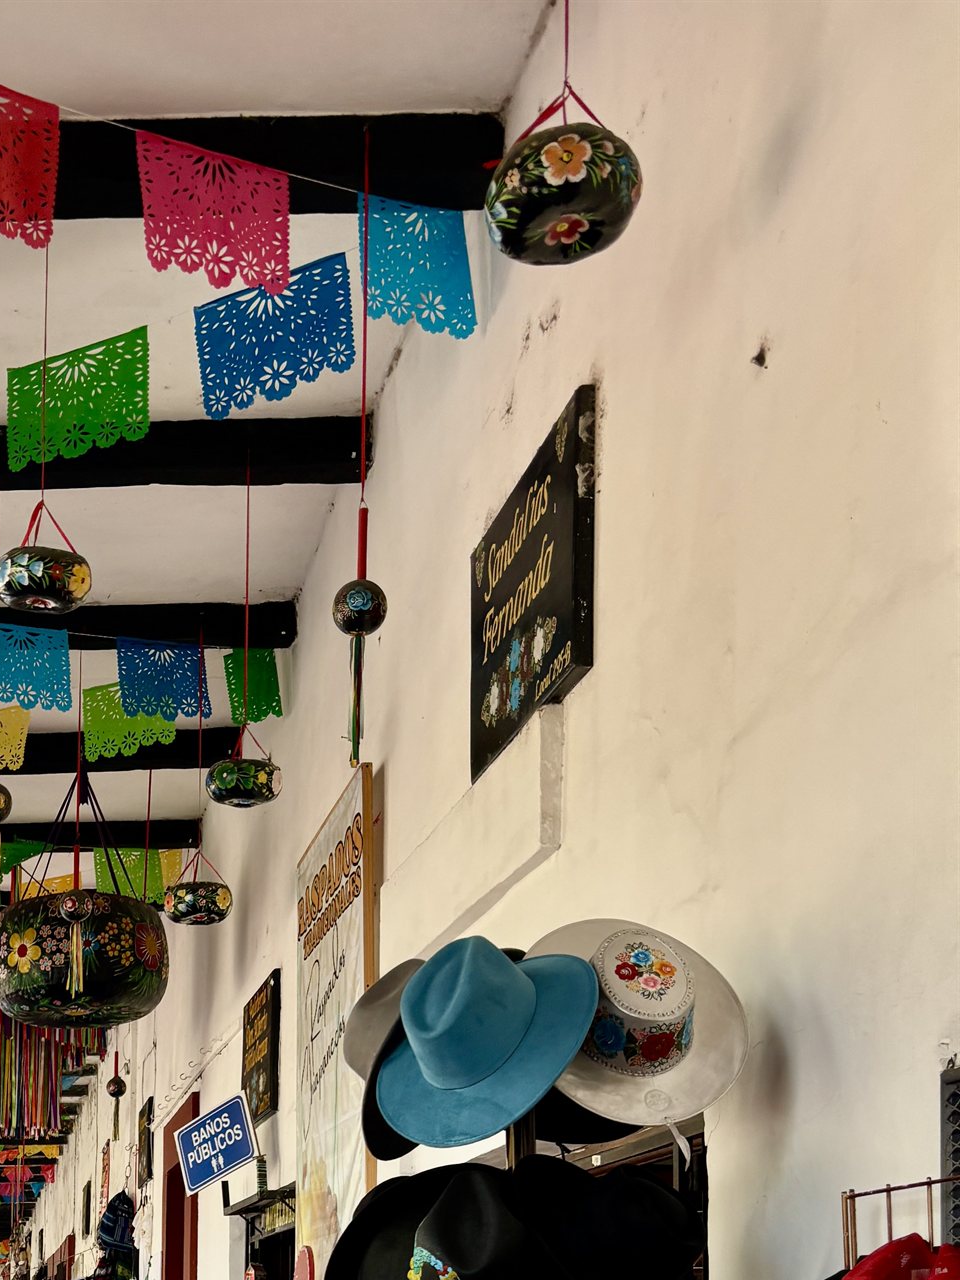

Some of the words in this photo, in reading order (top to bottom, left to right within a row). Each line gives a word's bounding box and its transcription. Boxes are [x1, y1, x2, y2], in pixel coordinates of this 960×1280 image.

[482, 533, 554, 666] Fernanda
[484, 474, 551, 603] Sandalias
[297, 812, 363, 942] RASPADOS
[187, 1124, 243, 1169] PÚBLICOS
[191, 1112, 231, 1147] BAÑOS
